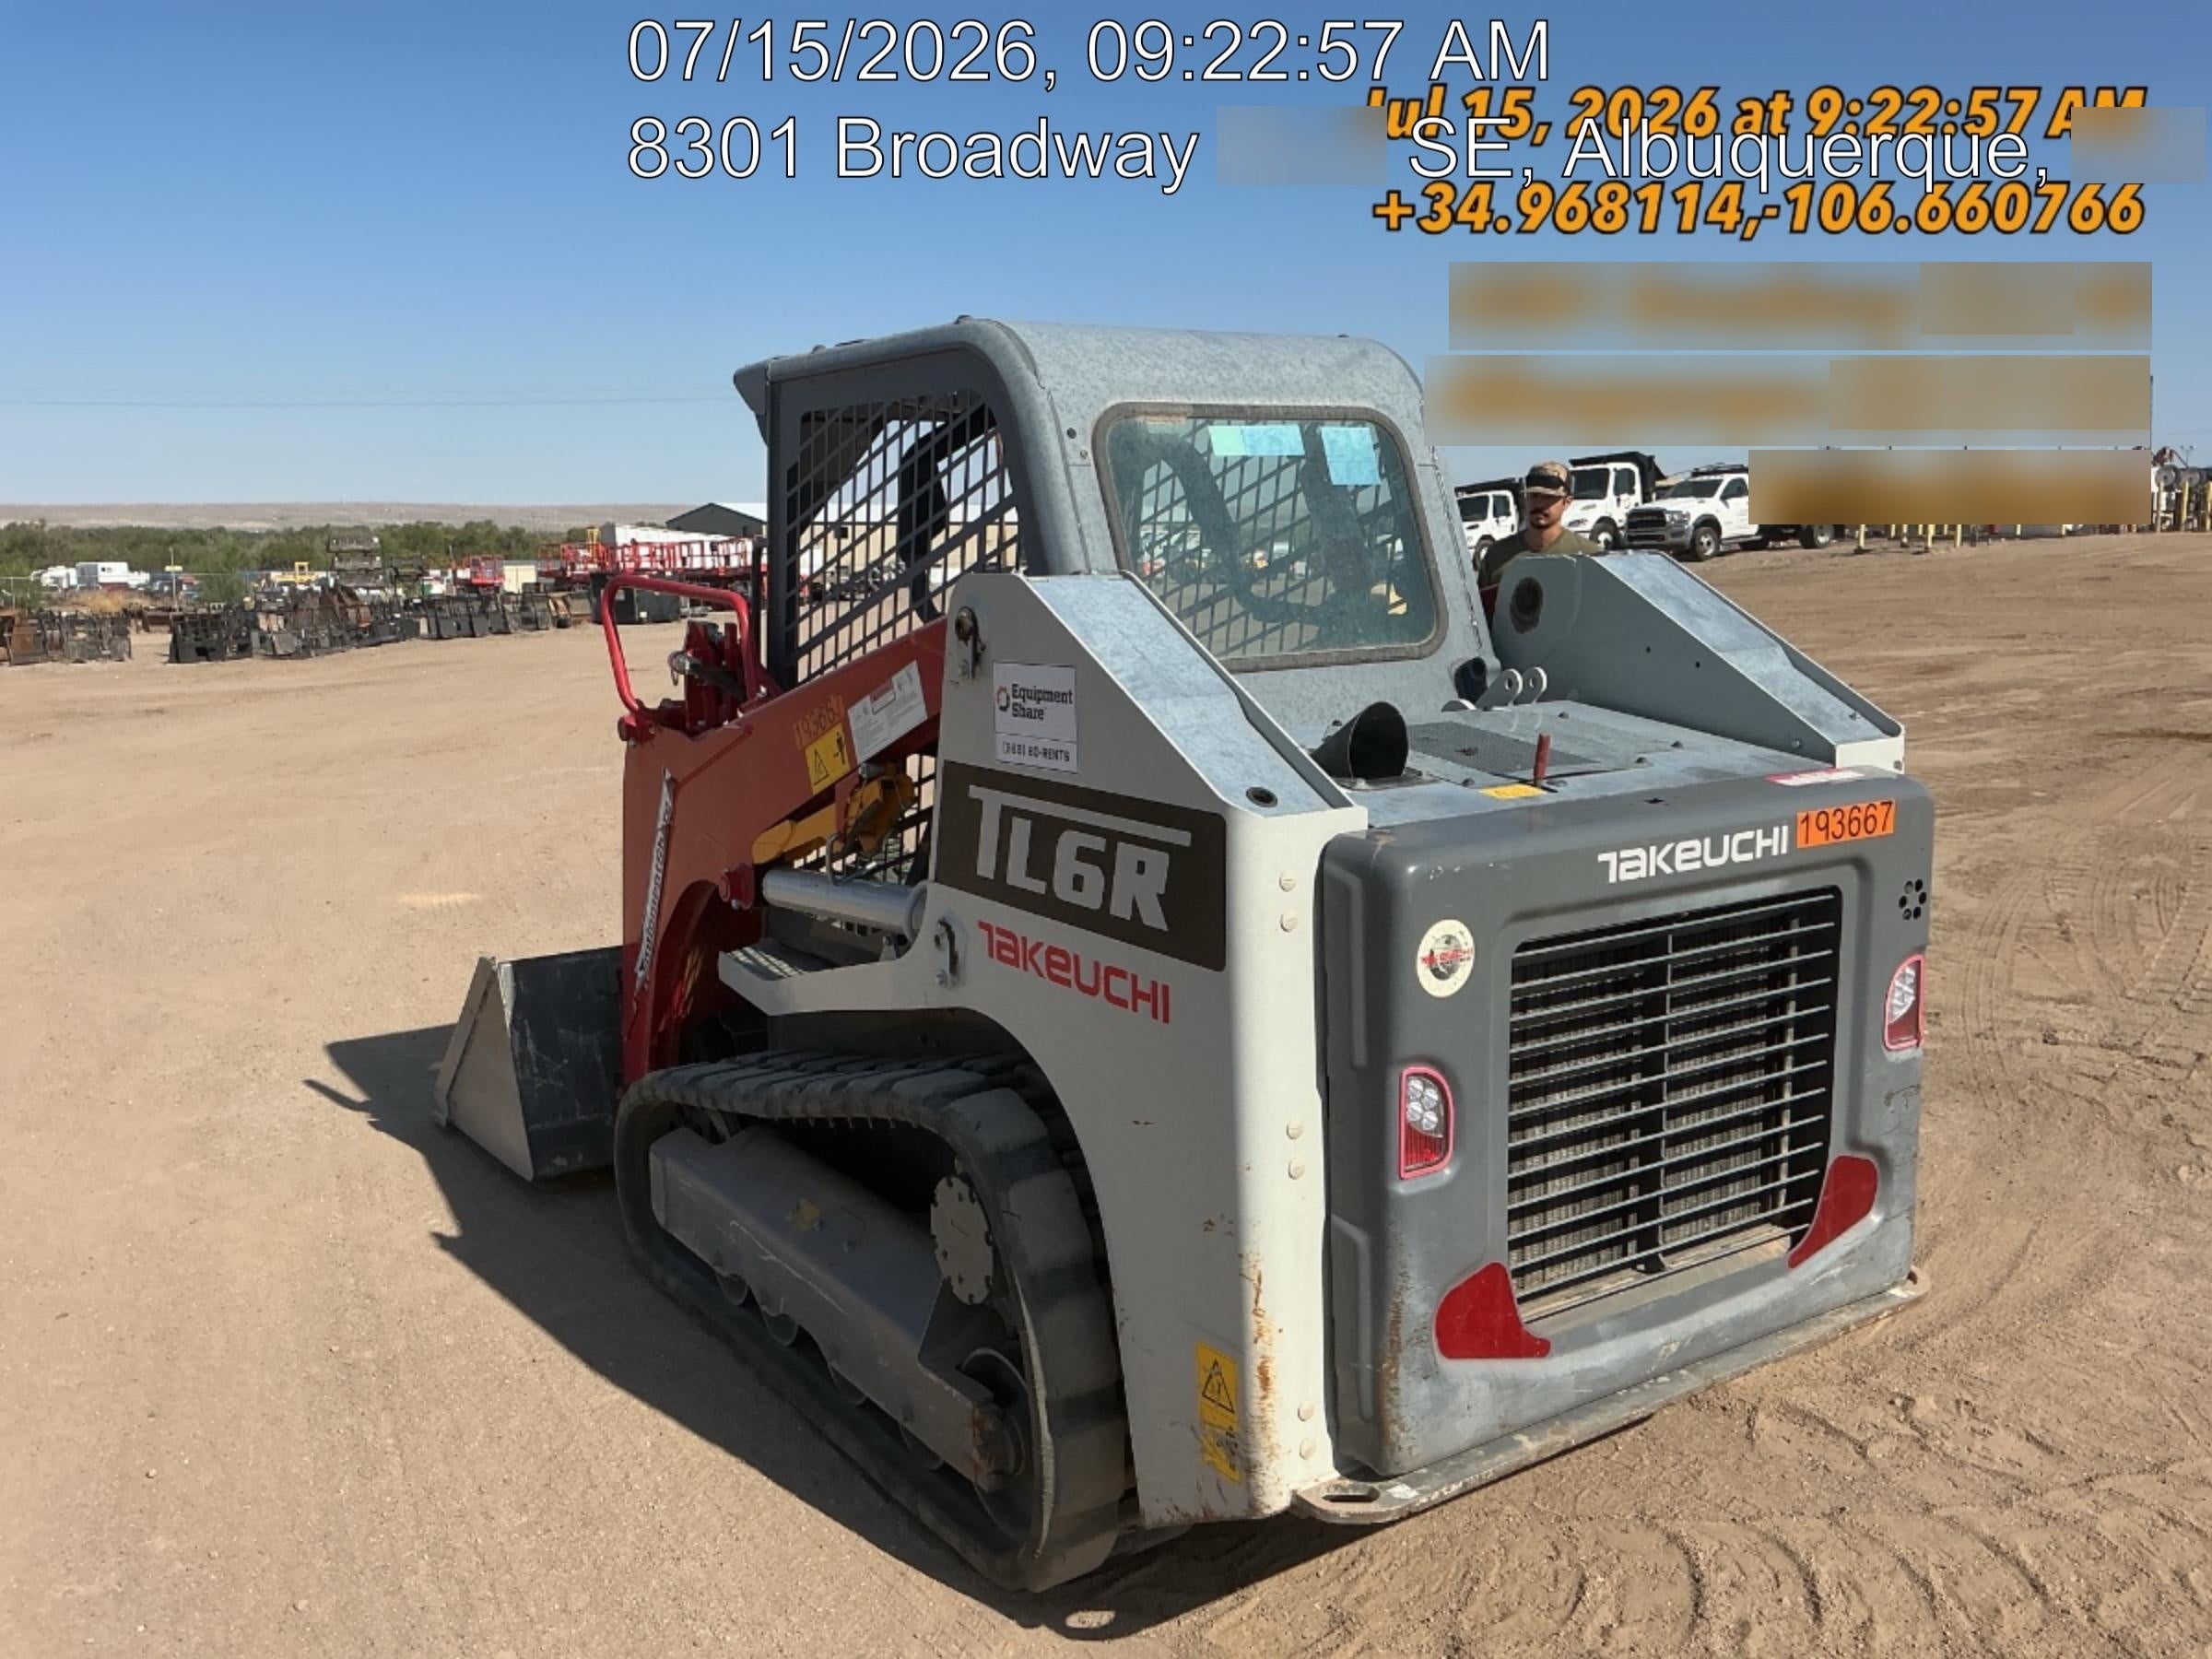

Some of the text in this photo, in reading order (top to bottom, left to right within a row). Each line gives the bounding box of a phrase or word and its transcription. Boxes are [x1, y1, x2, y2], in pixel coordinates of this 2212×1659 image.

[1011, 683, 1074, 705] Equipment
[1011, 702, 1044, 721] Share
[1798, 799, 1894, 847] 193667
[968, 783, 1192, 933] TL6R
